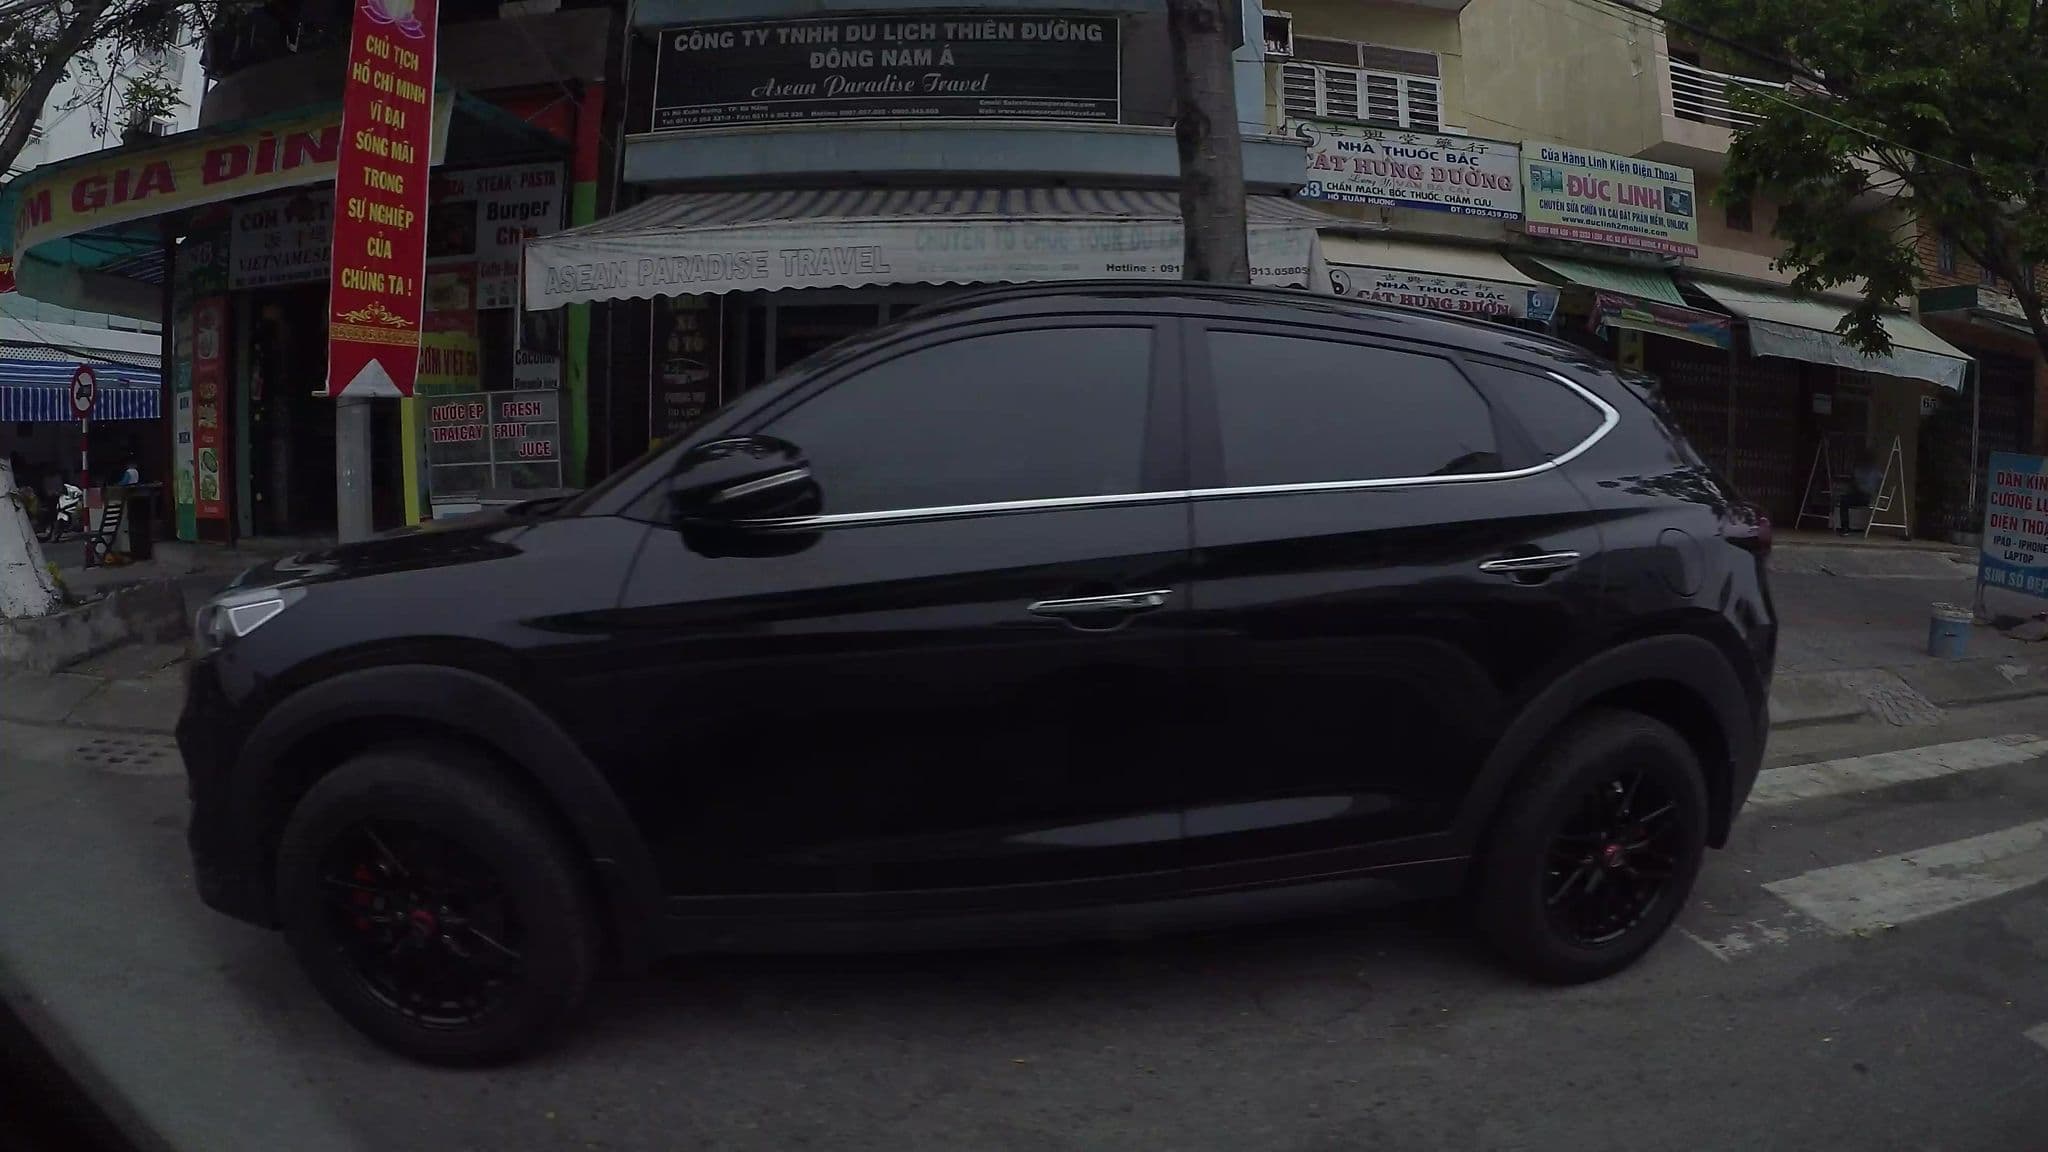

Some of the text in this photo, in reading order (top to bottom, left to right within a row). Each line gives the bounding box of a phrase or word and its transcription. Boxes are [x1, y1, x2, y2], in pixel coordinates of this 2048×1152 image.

[674, 19, 1103, 51] CÔNG TY TNHH DU LỊCH THIÊN ĐƯỜNG
[366, 34, 419, 72] CHỦ TỊCH
[810, 43, 955, 69] ĐÔNG NAM Á
[352, 59, 426, 104] HỒ CHÍ MINH
[751, 72, 991, 98] Asean Paradise Travel
[370, 100, 405, 131] VĨ ĐẠI
[356, 127, 414, 165] SỐNG MÃI
[1338, 140, 1479, 167] NHÀ THUỐC BẮC
[71, 159, 177, 213] GIA
[203, 126, 338, 185] ĐÌN
[520, 169, 556, 189] PASTA
[1307, 149, 1513, 191] ÁT HƯNG ĐƯỜNG
[1541, 148, 1678, 184] Cửa Hàng Linh Kiện Điện Thoại
[363, 166, 404, 194] TRONG
[1567, 173, 1664, 210] ĐỨC LINH
[487, 200, 551, 221] Burger
[1342, 193, 1366, 205] XUÂN
[1368, 196, 1396, 207] HƯƠNG
[348, 197, 367, 223] SỰ
[369, 201, 414, 231] NGHIỆP
[1539, 199, 1565, 212] CHUYÊN
[1666, 218, 1689, 232] UNLOCK
[1561, 215, 1668, 238] www.duclinh2mobile.com
[367, 231, 392, 259] CỦA
[341, 266, 385, 294] CHÚNG
[388, 275, 404, 296] TA
[544, 261, 628, 296] ASEAN
[638, 251, 770, 287] PARADISE
[780, 245, 891, 278] TRAVEL
[1106, 263, 1147, 275] Hotline
[1160, 264, 1184, 275] 091
[1399, 291, 1458, 312] HƯNG
[1459, 298, 1512, 316] ĐƯỜN
[432, 401, 541, 421] NƯỚC ÉP FRESH
[494, 423, 527, 439] FRUIT
[519, 440, 551, 457] JUCE
[2026, 472, 2048, 491] KÍN
[1991, 489, 2033, 511] CƯỜNG
[1993, 535, 2013, 547] IPAD
[2018, 537, 2048, 553] IPHONE
[2004, 549, 2034, 565] LAPTOP
[1984, 566, 2006, 585] SIM
[2009, 569, 2025, 589] SỐ
